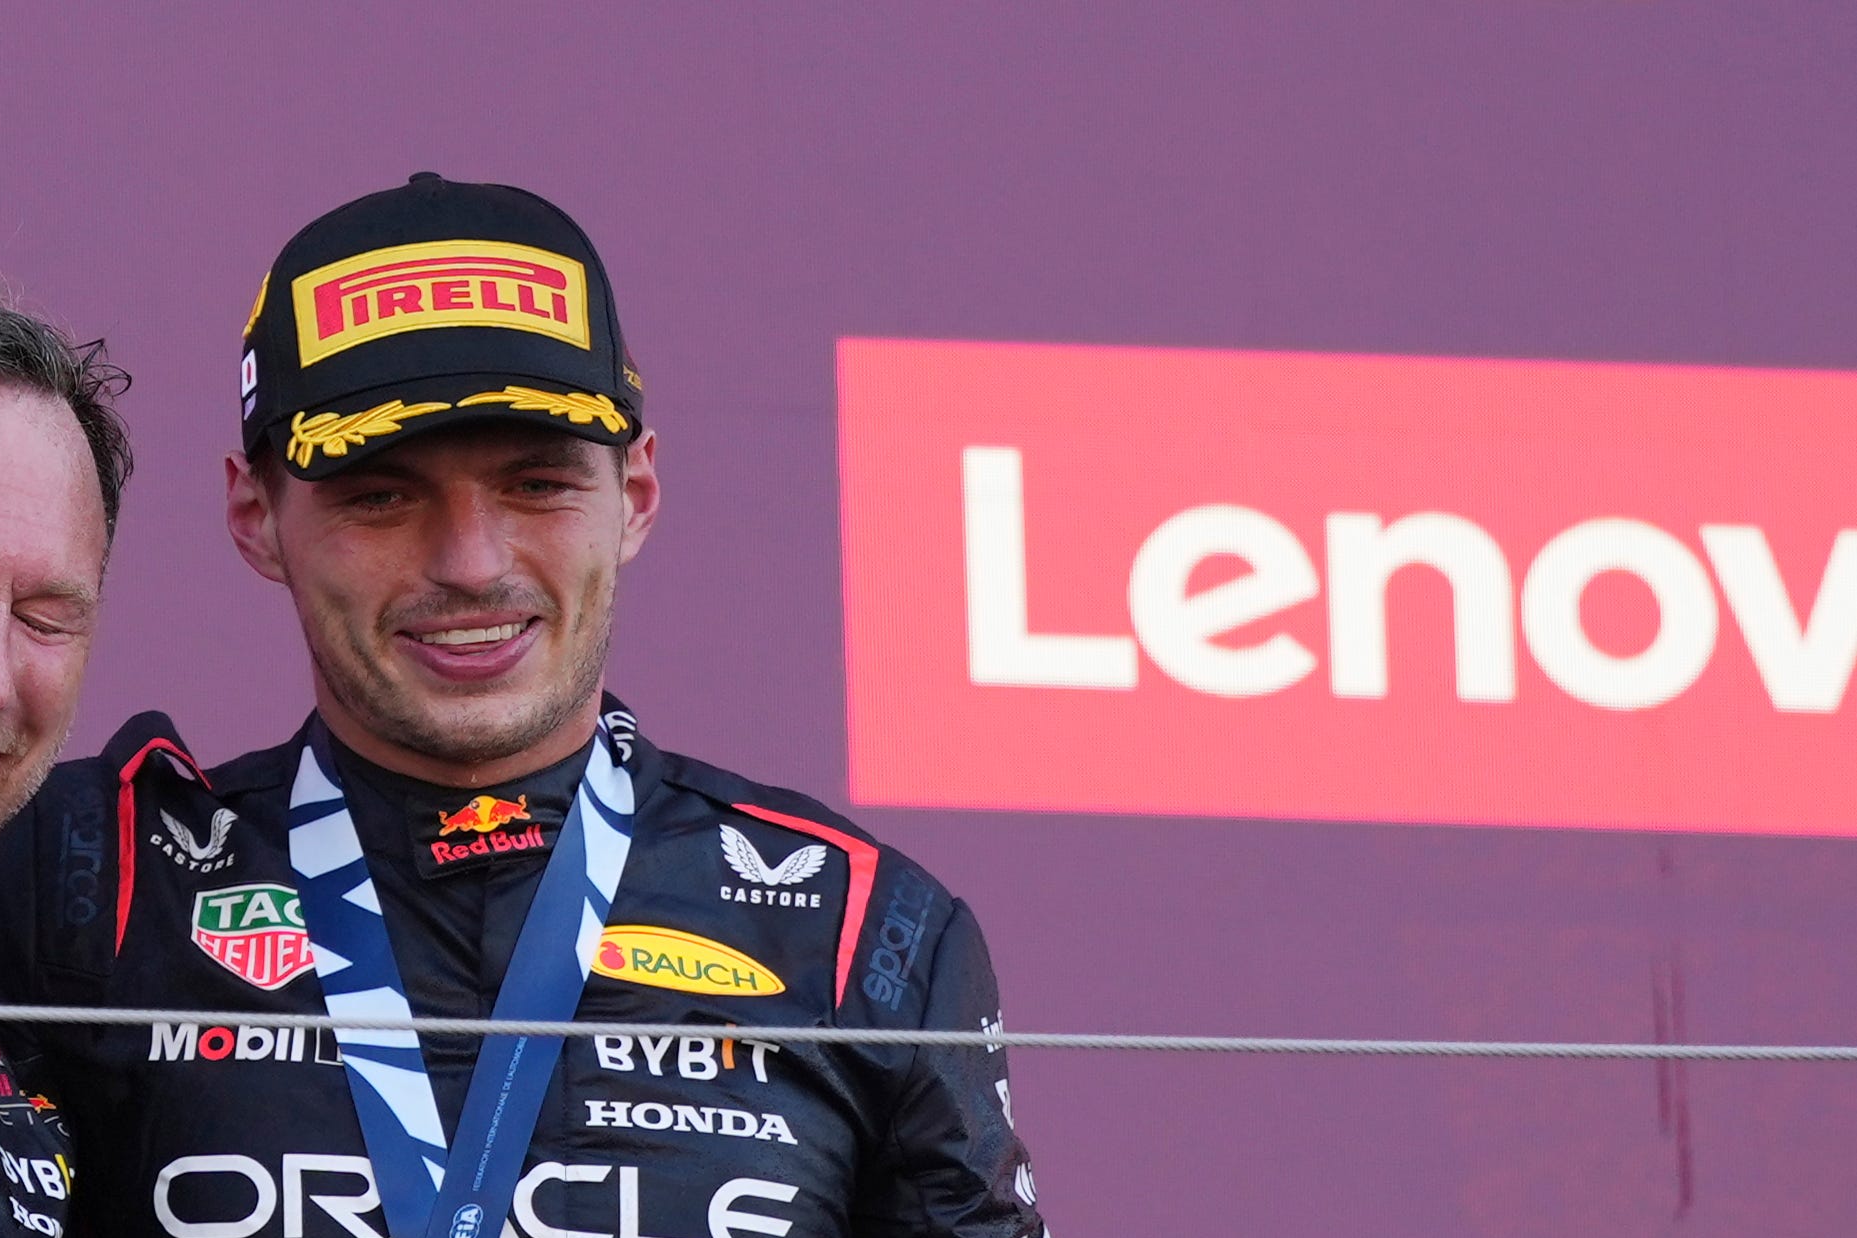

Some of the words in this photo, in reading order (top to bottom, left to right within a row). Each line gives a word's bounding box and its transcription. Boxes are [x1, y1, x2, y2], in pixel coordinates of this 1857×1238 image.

[313, 256, 569, 341] PIRELLI
[149, 832, 235, 873] CASTORE
[430, 834, 490, 864] Red
[488, 823, 544, 852] Bull
[719, 886, 822, 908] CASTORE
[631, 947, 759, 991] RAUCH
[147, 1022, 306, 1062] Mobil
[593, 1022, 781, 1084] BYBIT
[584, 1099, 799, 1146] HONDA
